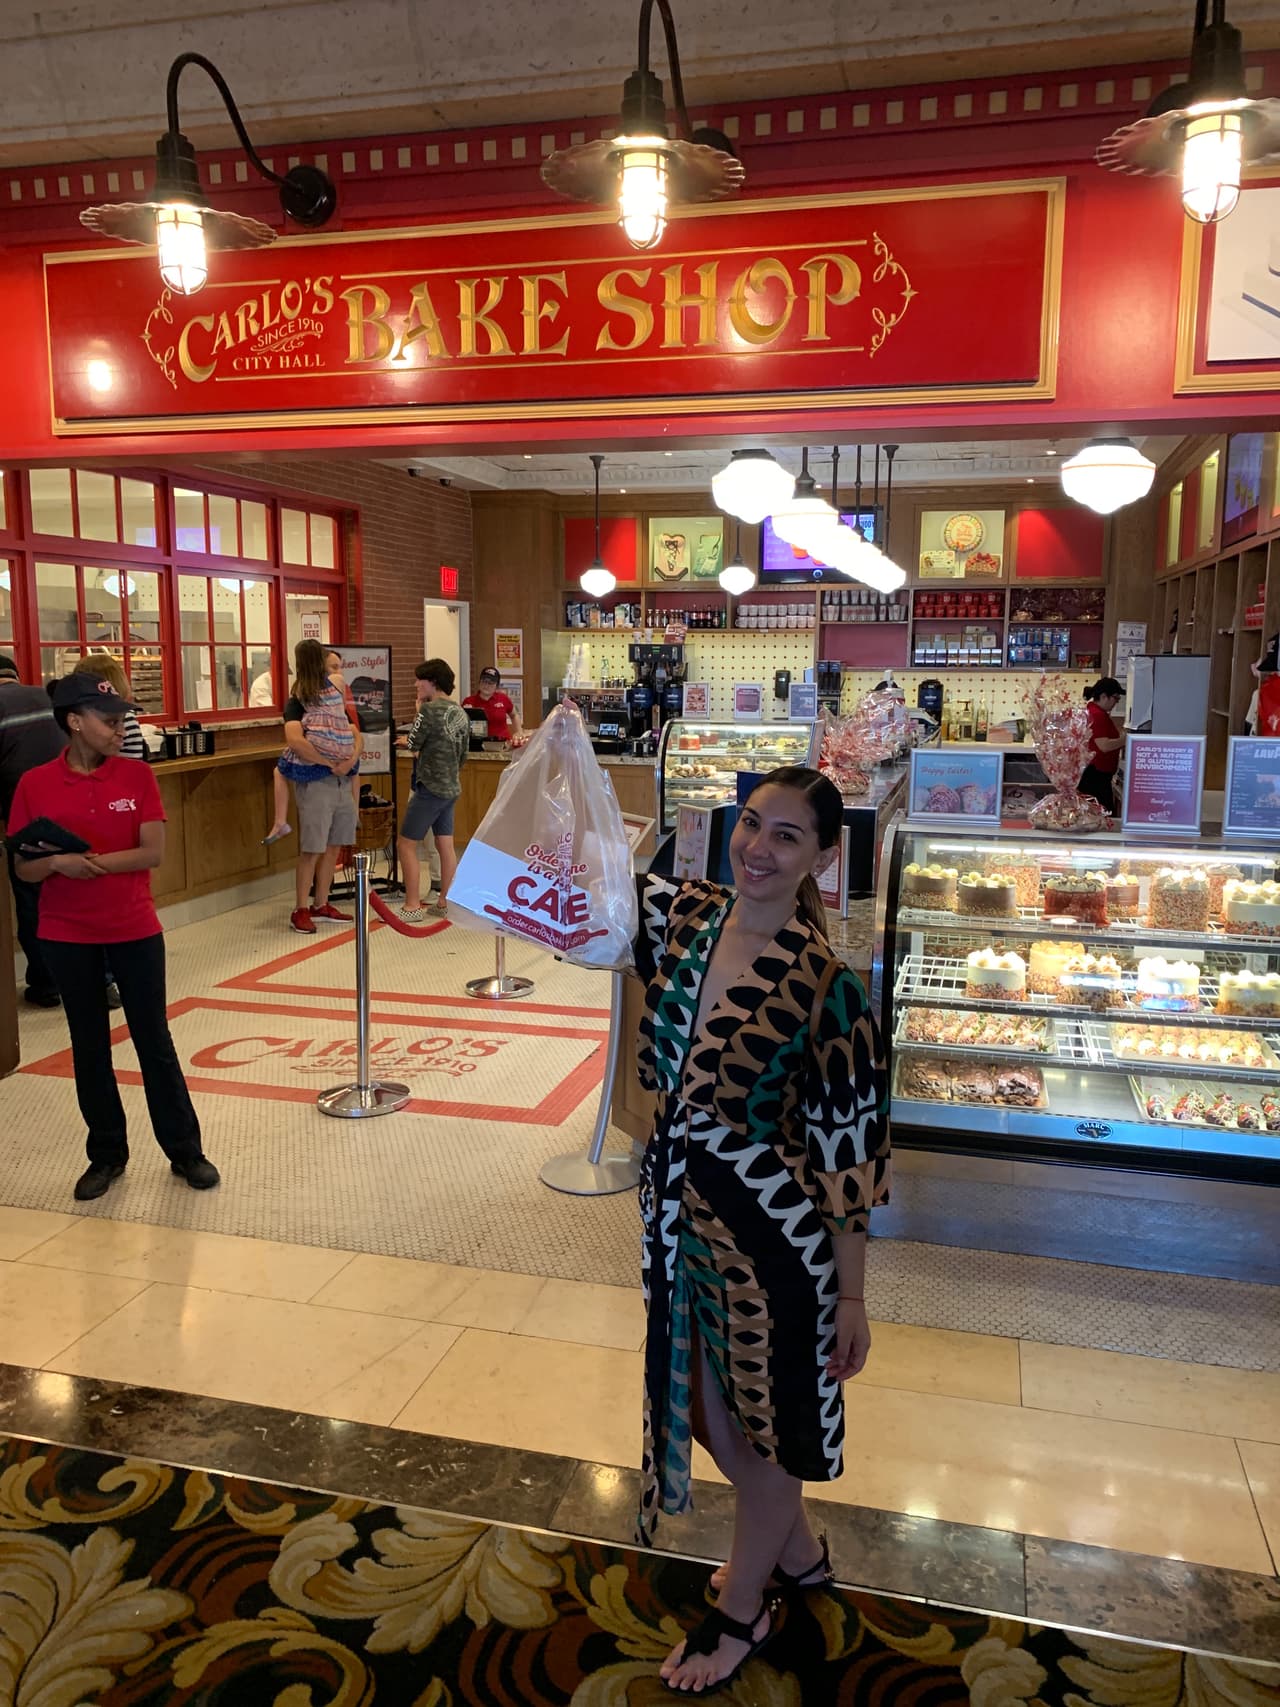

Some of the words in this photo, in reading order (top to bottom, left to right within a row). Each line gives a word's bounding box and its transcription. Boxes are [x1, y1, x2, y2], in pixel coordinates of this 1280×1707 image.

[340, 271, 569, 363] BAKE
[595, 253, 861, 351] SHOP
[178, 276, 334, 383] CARLO'S
[257, 321, 295, 348] SINCE
[298, 317, 324, 334] 1910
[233, 356, 273, 370] CITY
[280, 353, 326, 368] HALL
[527, 861, 542, 875] is
[543, 871, 556, 881] a
[422, 1056, 477, 1072] 1910
